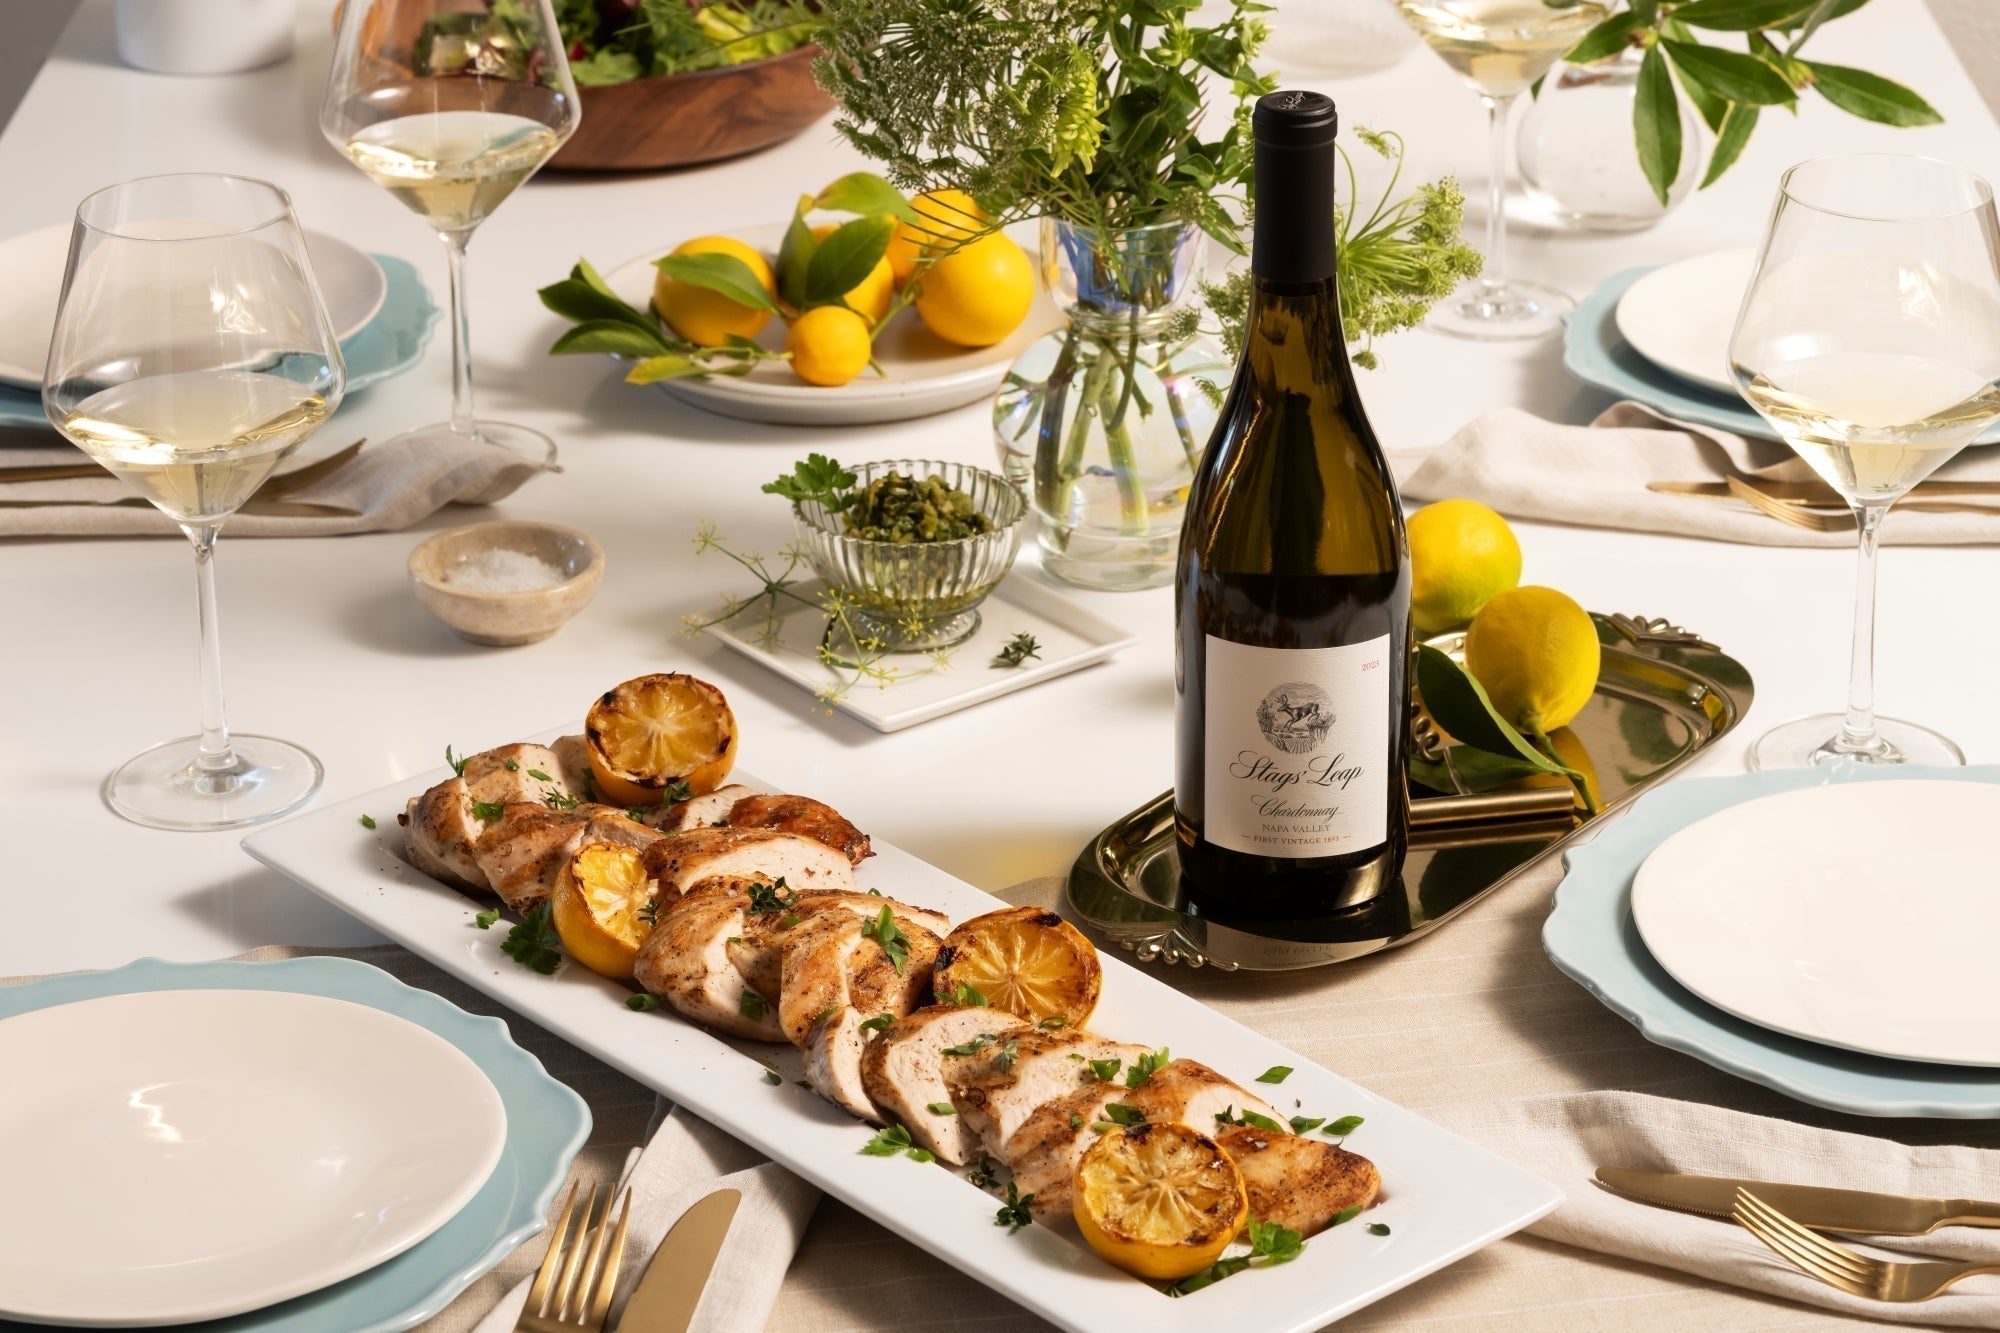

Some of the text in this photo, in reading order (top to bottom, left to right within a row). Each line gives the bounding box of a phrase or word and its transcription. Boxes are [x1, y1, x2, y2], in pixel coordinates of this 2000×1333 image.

[1229, 750, 1365, 793] Stags' Leap
[1250, 794, 1344, 824] Chardonnay
[1262, 823, 1331, 833] NAPA VALLEY
[1253, 835, 1279, 844] FIRST
[1281, 837, 1321, 845] VINTAGE
